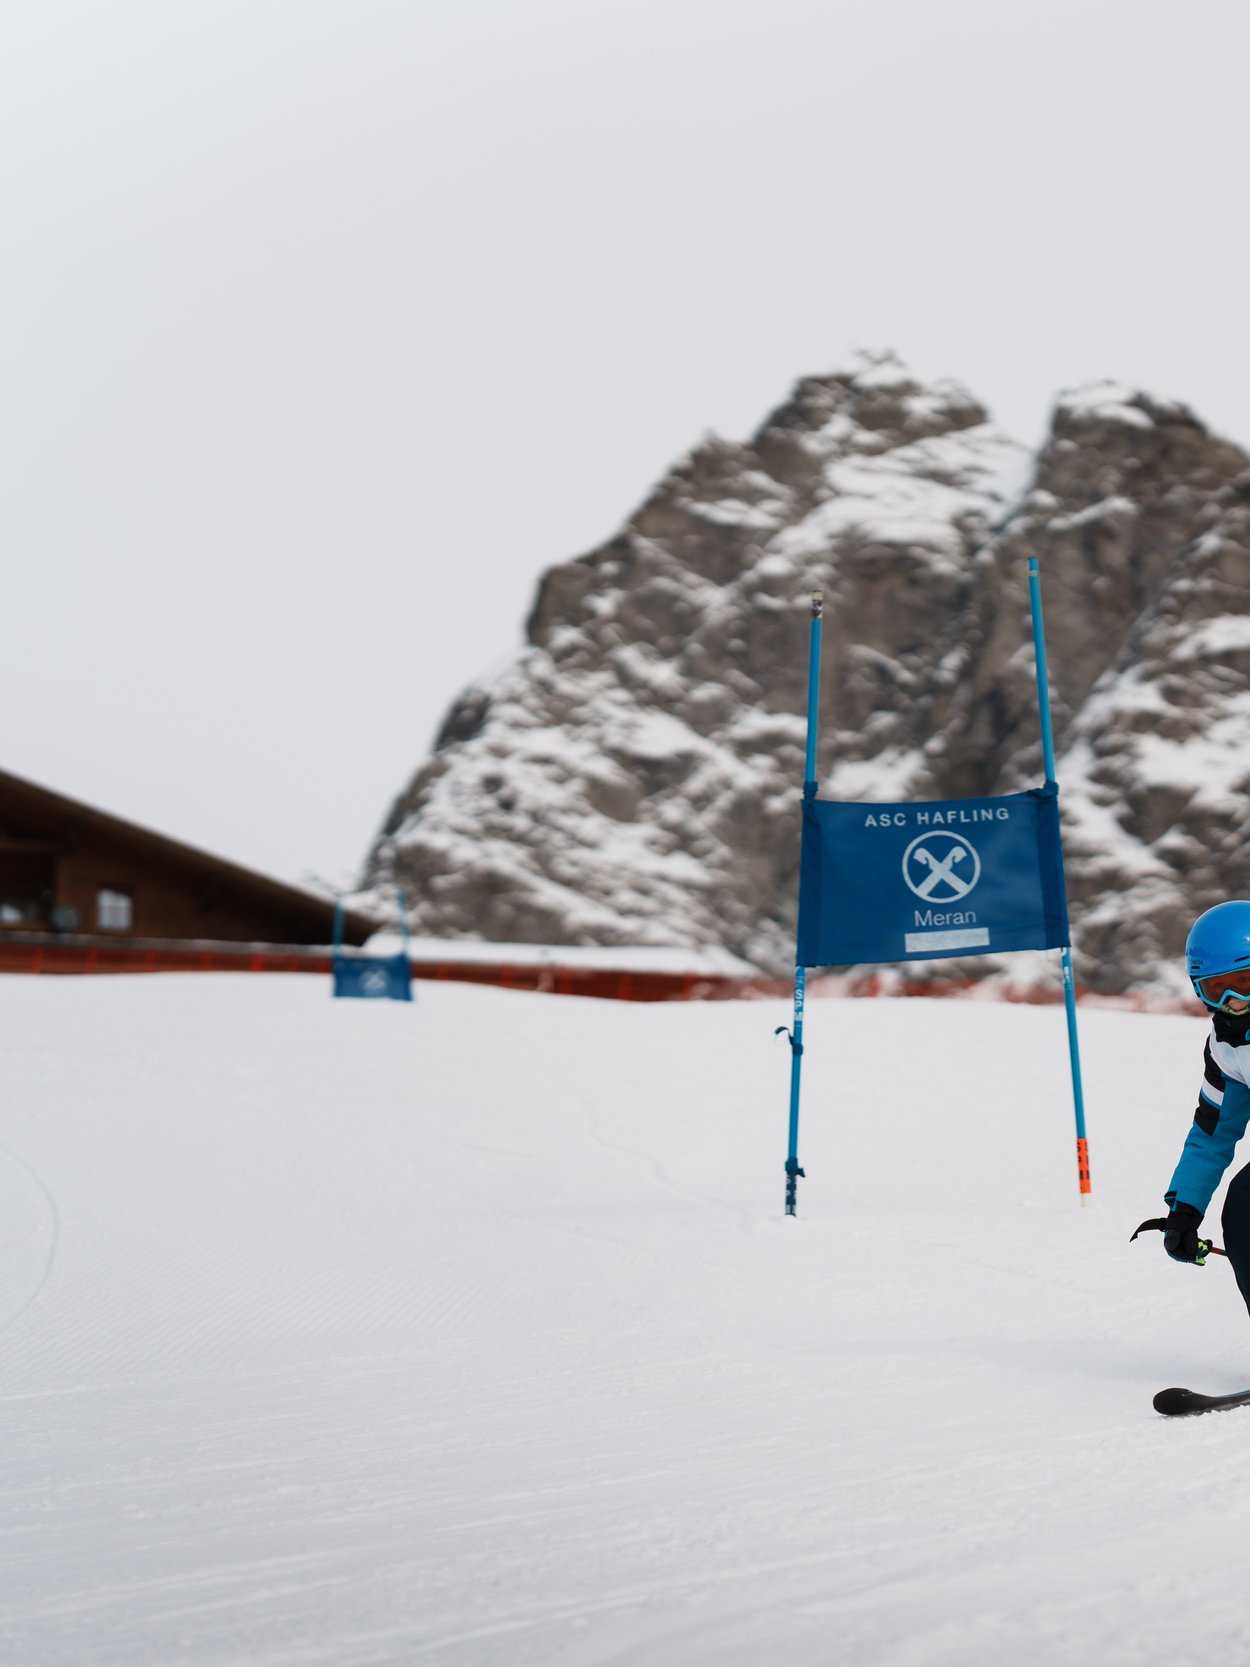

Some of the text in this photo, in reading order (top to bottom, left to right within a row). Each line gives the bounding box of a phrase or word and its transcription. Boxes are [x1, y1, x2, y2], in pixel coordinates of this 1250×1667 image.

[864, 807, 1010, 828] ASC HAFLING
[914, 909, 977, 927] Meran
